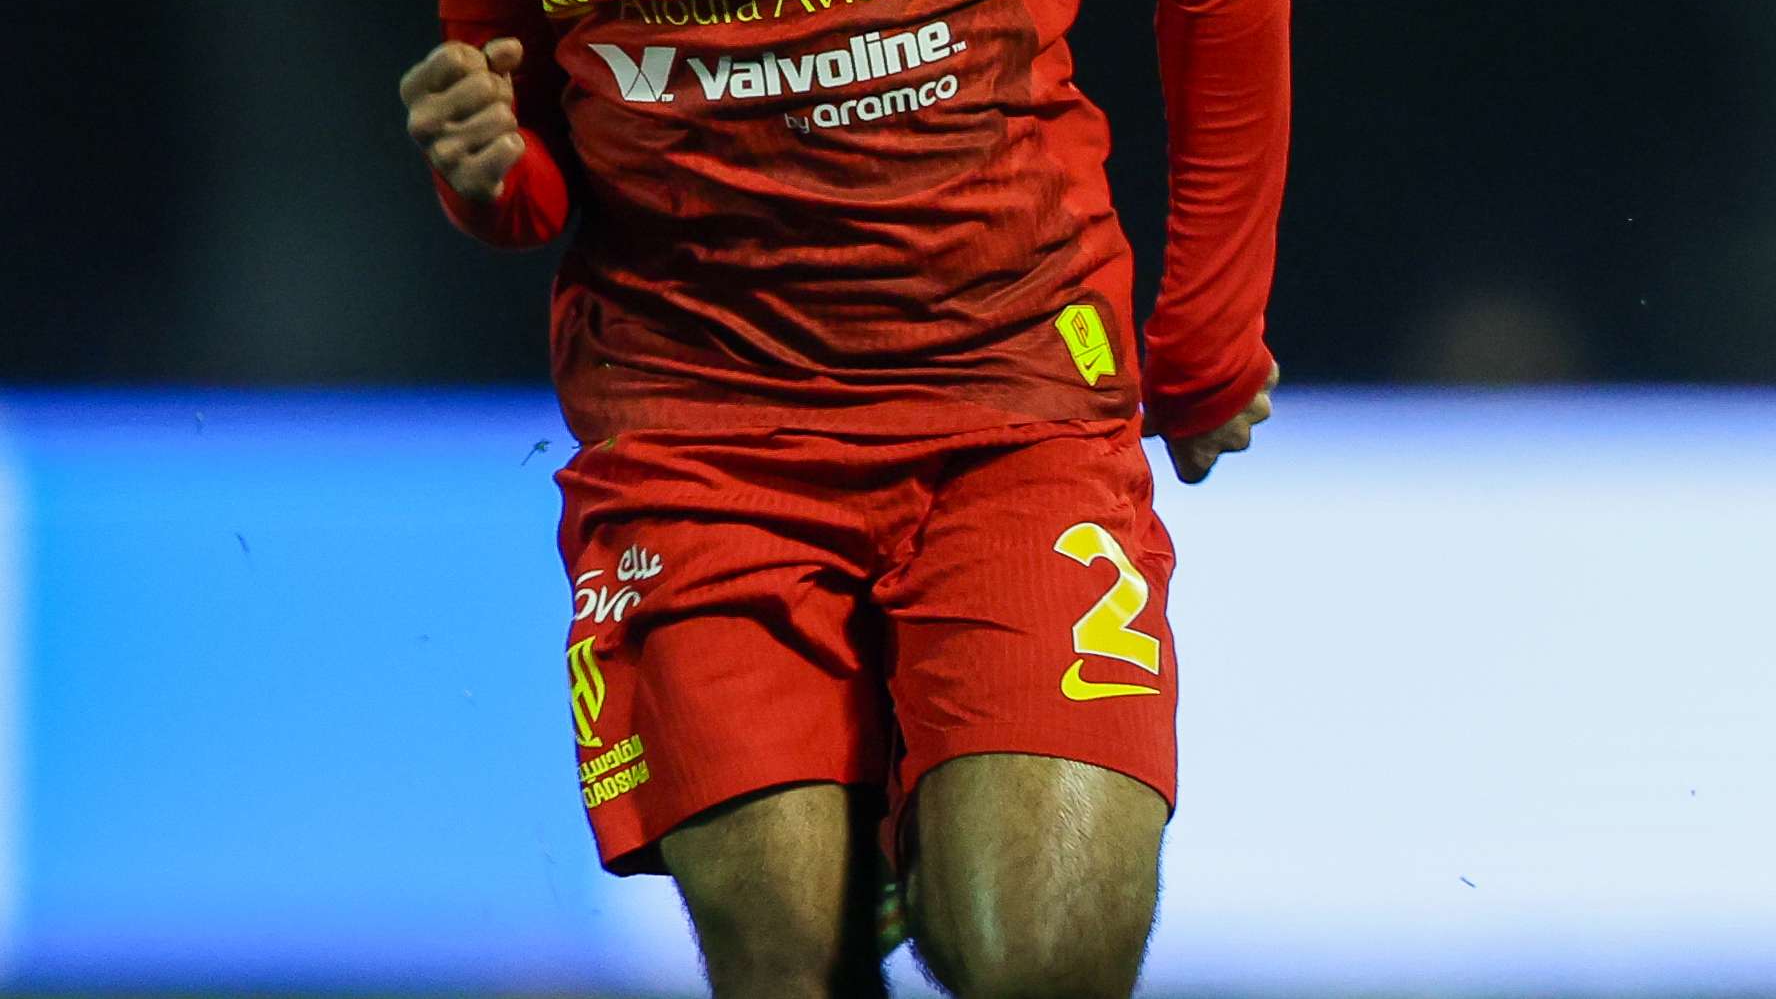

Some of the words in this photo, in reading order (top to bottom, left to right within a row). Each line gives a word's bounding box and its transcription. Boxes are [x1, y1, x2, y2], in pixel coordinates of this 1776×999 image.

[687, 20, 951, 100] Valvoline
[812, 74, 959, 128] aramco
[1054, 522, 1160, 675] 2
